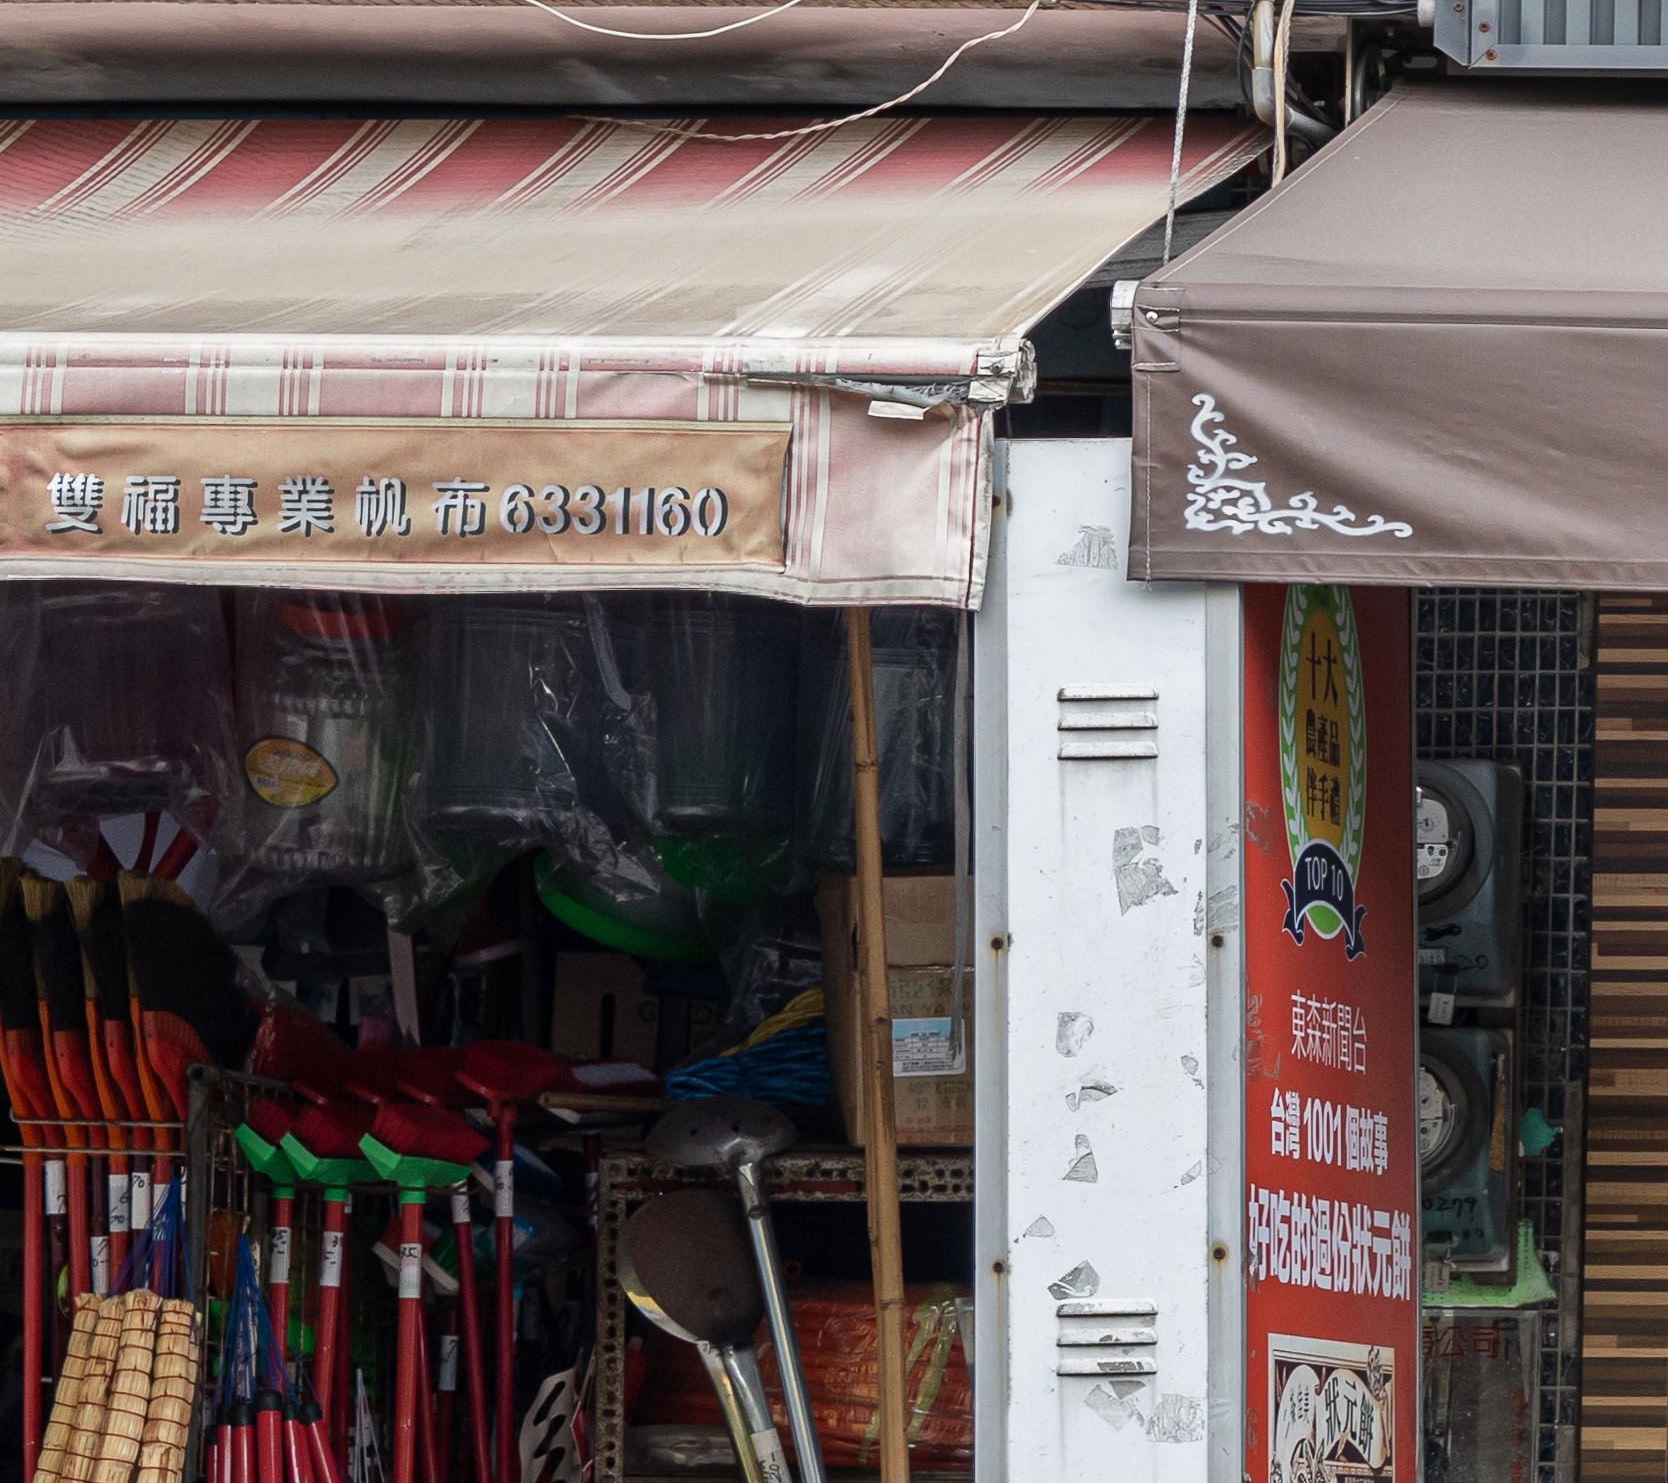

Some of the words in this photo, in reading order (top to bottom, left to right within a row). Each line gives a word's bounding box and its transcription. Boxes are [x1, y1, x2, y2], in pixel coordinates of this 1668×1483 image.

[1305, 630, 1339, 707] 十大
[1305, 707, 1341, 768] 農產品
[1305, 767, 1341, 826] 伴手禮
[1304, 856, 1327, 891] TOP
[1331, 864, 1344, 902] 10
[1290, 988, 1367, 1075] 東森新聞台
